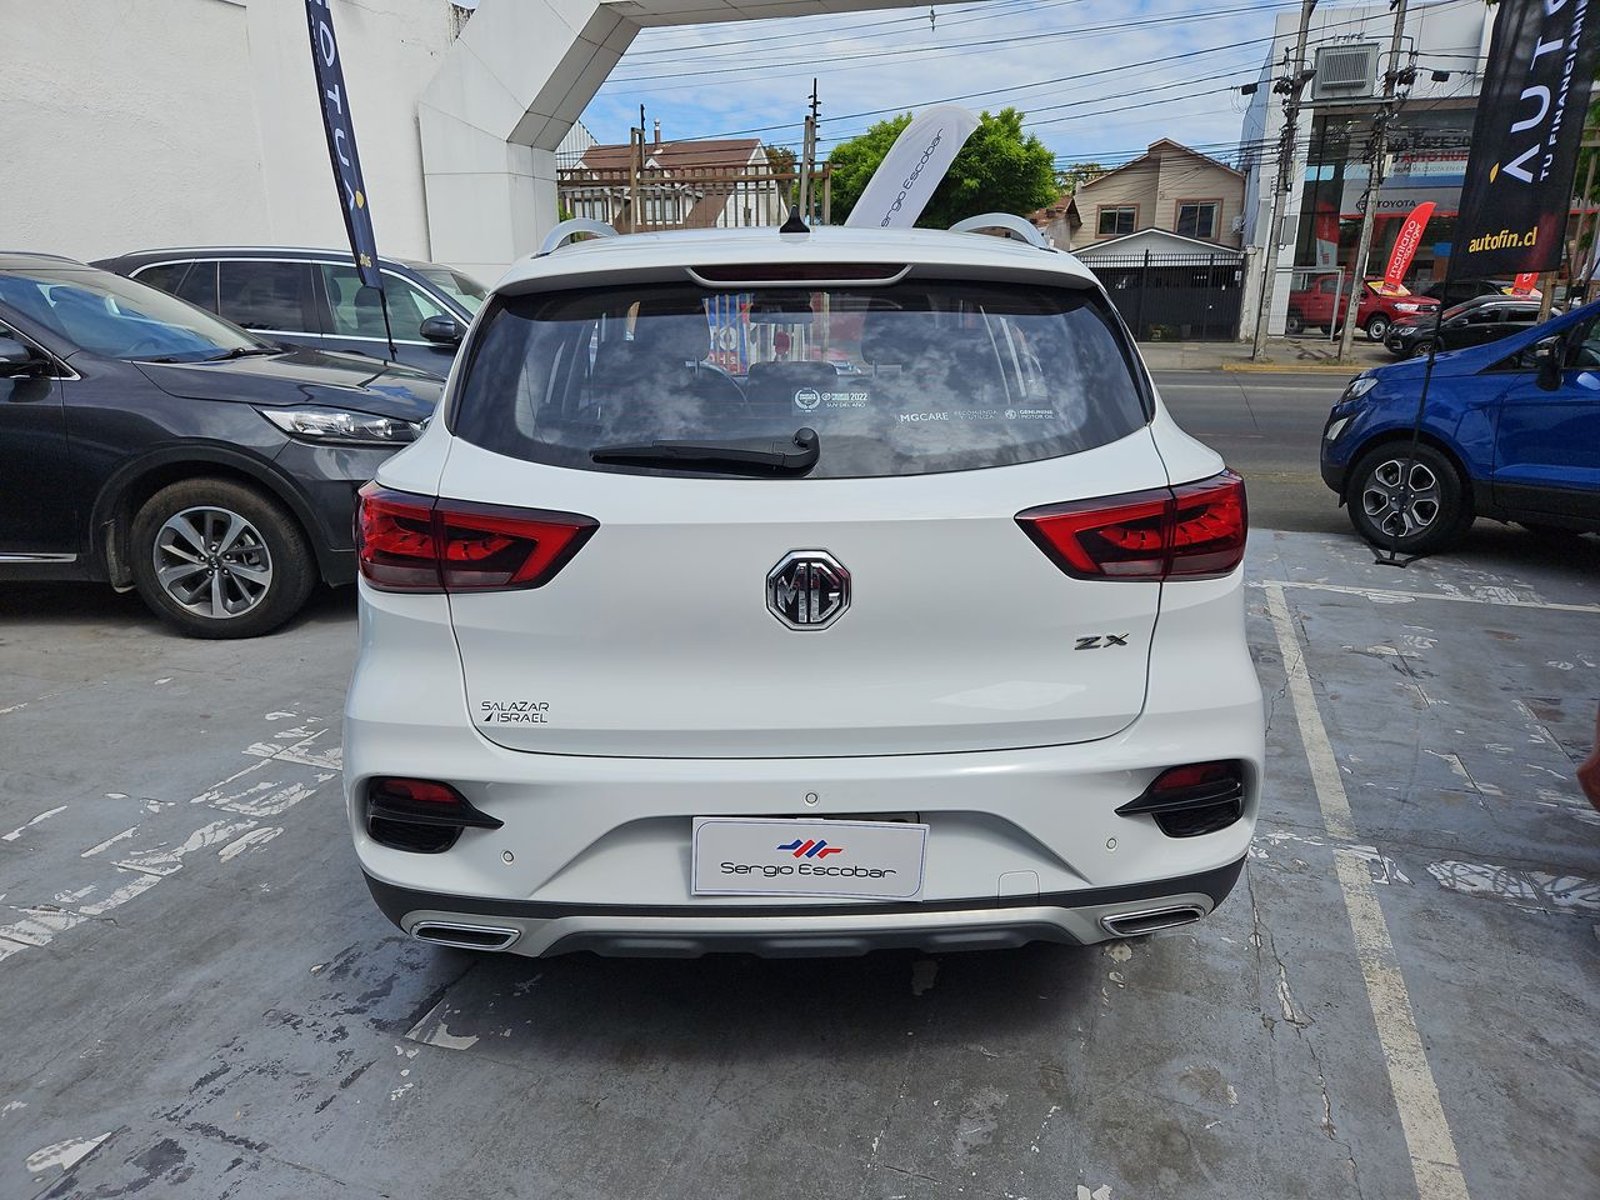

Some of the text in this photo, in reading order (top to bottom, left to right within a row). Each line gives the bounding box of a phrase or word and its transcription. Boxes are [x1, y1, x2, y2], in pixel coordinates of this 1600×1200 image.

[1540, 153, 1554, 182] TU
[881, 128, 943, 227] ergio Escobar
[1468, 226, 1538, 253] autofin.cl
[850, 392, 868, 401] 2022
[899, 411, 949, 422] MGCARE
[777, 561, 841, 623] MG
[1074, 633, 1129, 650] ZX
[481, 701, 550, 711] SALAZAR
[497, 712, 548, 723] ISRAEL
[720, 861, 897, 879] Sergio Escobar
